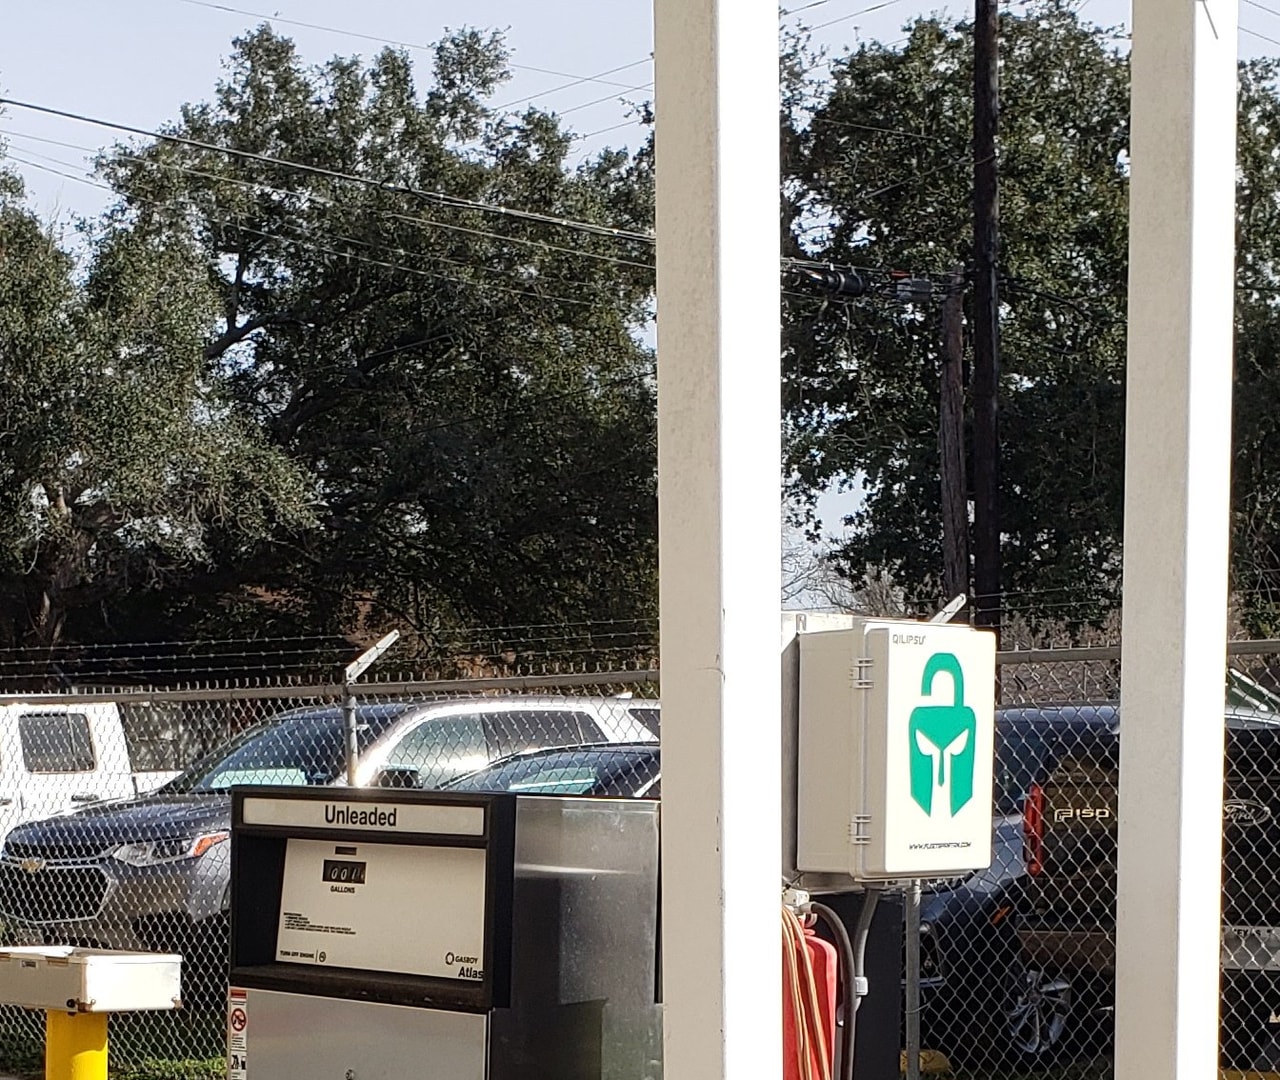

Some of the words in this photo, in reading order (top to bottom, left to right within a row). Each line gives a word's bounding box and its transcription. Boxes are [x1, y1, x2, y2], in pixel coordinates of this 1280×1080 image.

[325, 804, 397, 827] Unleaded
[330, 885, 355, 894] GALLONS
[458, 966, 485, 979] Atlas
